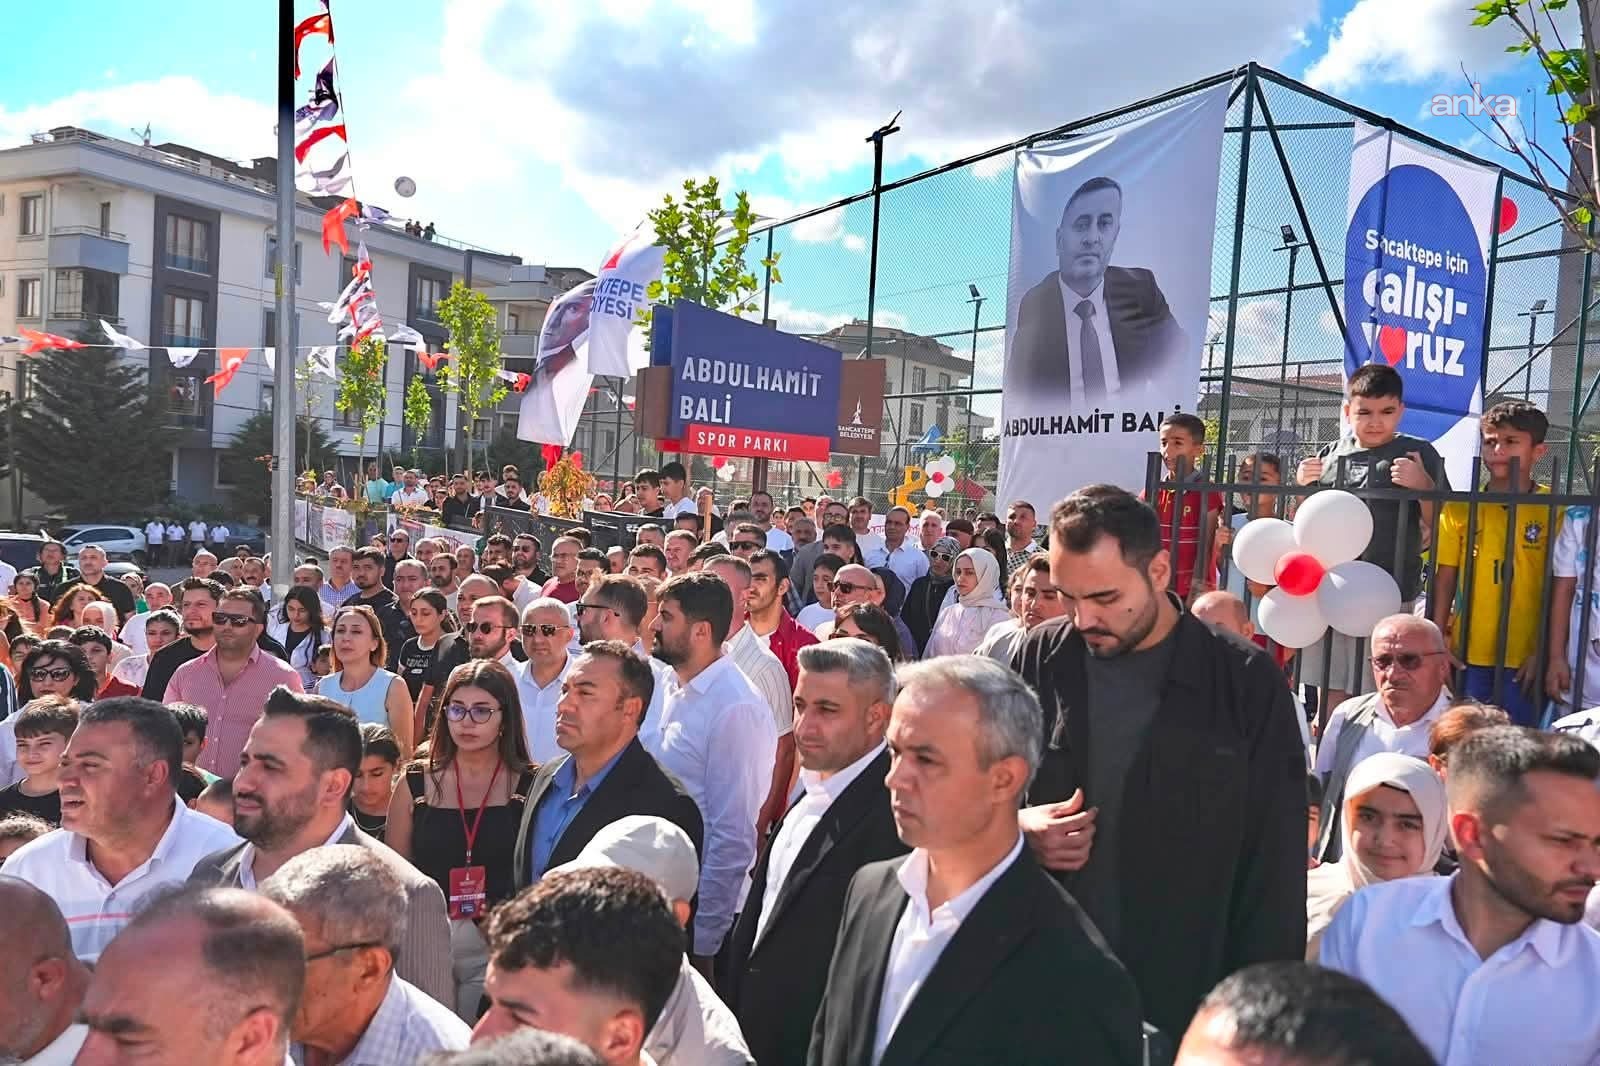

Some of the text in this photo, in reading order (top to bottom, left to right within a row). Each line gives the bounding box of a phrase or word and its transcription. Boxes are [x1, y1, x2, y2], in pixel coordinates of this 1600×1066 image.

[1365, 229, 1469, 275] Sncaktepe için
[681, 356, 822, 397] ABDULHAMİT
[679, 394, 732, 424] BALİ
[1004, 405, 1181, 437] ABDULHAMİT BAL
[698, 431, 788, 453] SPOR PARKI
